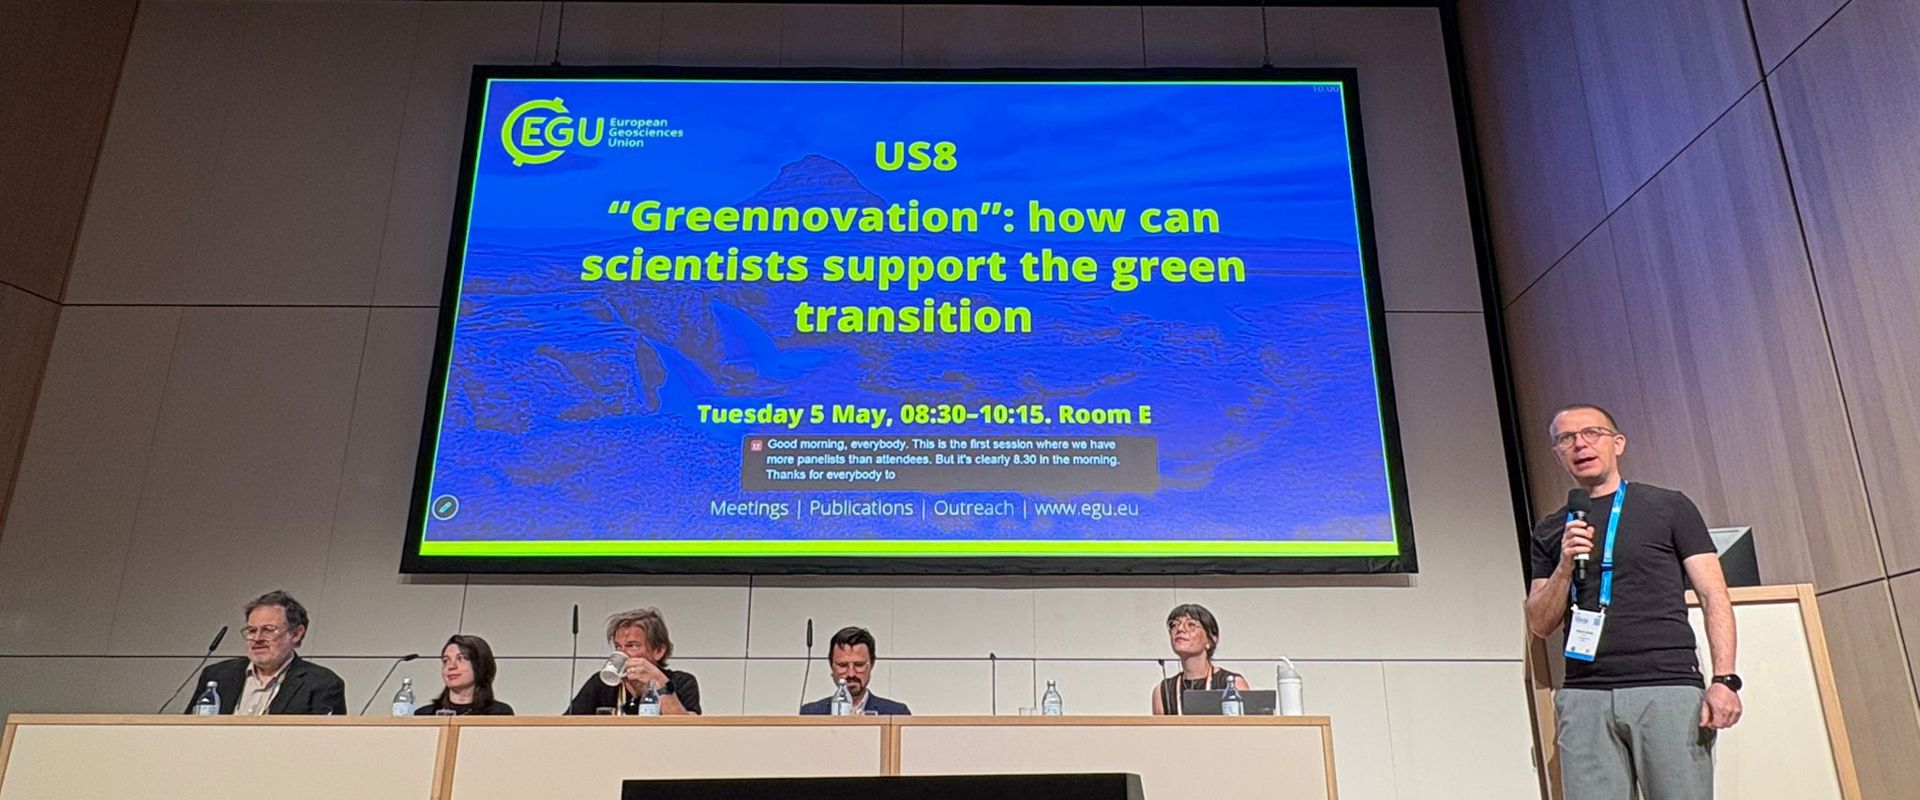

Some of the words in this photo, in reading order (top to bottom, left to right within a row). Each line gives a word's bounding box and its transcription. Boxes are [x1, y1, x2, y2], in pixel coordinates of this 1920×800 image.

[521, 116, 604, 147] EGU
[609, 128, 683, 137] Geosciences
[610, 118, 668, 129] European
[608, 138, 644, 147] Union
[876, 141, 957, 171] US8
[1029, 200, 1125, 232] how
[1140, 208, 1219, 233] can
[581, 247, 808, 281] scientists
[823, 252, 1006, 291] support
[1020, 249, 1097, 282] the
[1112, 257, 1245, 291] green
[794, 298, 1031, 332] transition
[698, 404, 804, 429] Tuesday
[810, 405, 824, 423] 5
[833, 405, 893, 429] May,
[1059, 405, 1131, 424] Room
[1139, 406, 1151, 424] E
[767, 439, 797, 449] Good
[801, 439, 847, 451] morning,
[851, 440, 908, 451] everybody.
[912, 439, 935, 449] This
[938, 439, 947, 449] is
[950, 439, 967, 449] the
[970, 439, 990, 449] first
[993, 439, 1033, 449] session
[1036, 439, 1069, 449] where
[1072, 441, 1087, 449] we
[1090, 439, 1116, 449] have
[767, 456, 794, 464] more
[797, 454, 845, 466] panelists
[849, 454, 872, 464] than
[876, 454, 931, 464] attendees.
[936, 455, 954, 464] But
[975, 454, 1009, 466] clearly
[1013, 454, 1036, 464] 8.30
[1040, 454, 1049, 464] in
[1053, 454, 1069, 464] the
[1073, 455, 1120, 466] morning.
[766, 470, 806, 480] Thanks
[809, 470, 823, 480] for
[827, 470, 881, 482] everybody
[885, 470, 895, 480] to
[710, 500, 789, 519] Meetings
[810, 500, 913, 516] Publications
[934, 500, 1014, 516] Outreach
[1035, 503, 1139, 519] www.egu.eu
